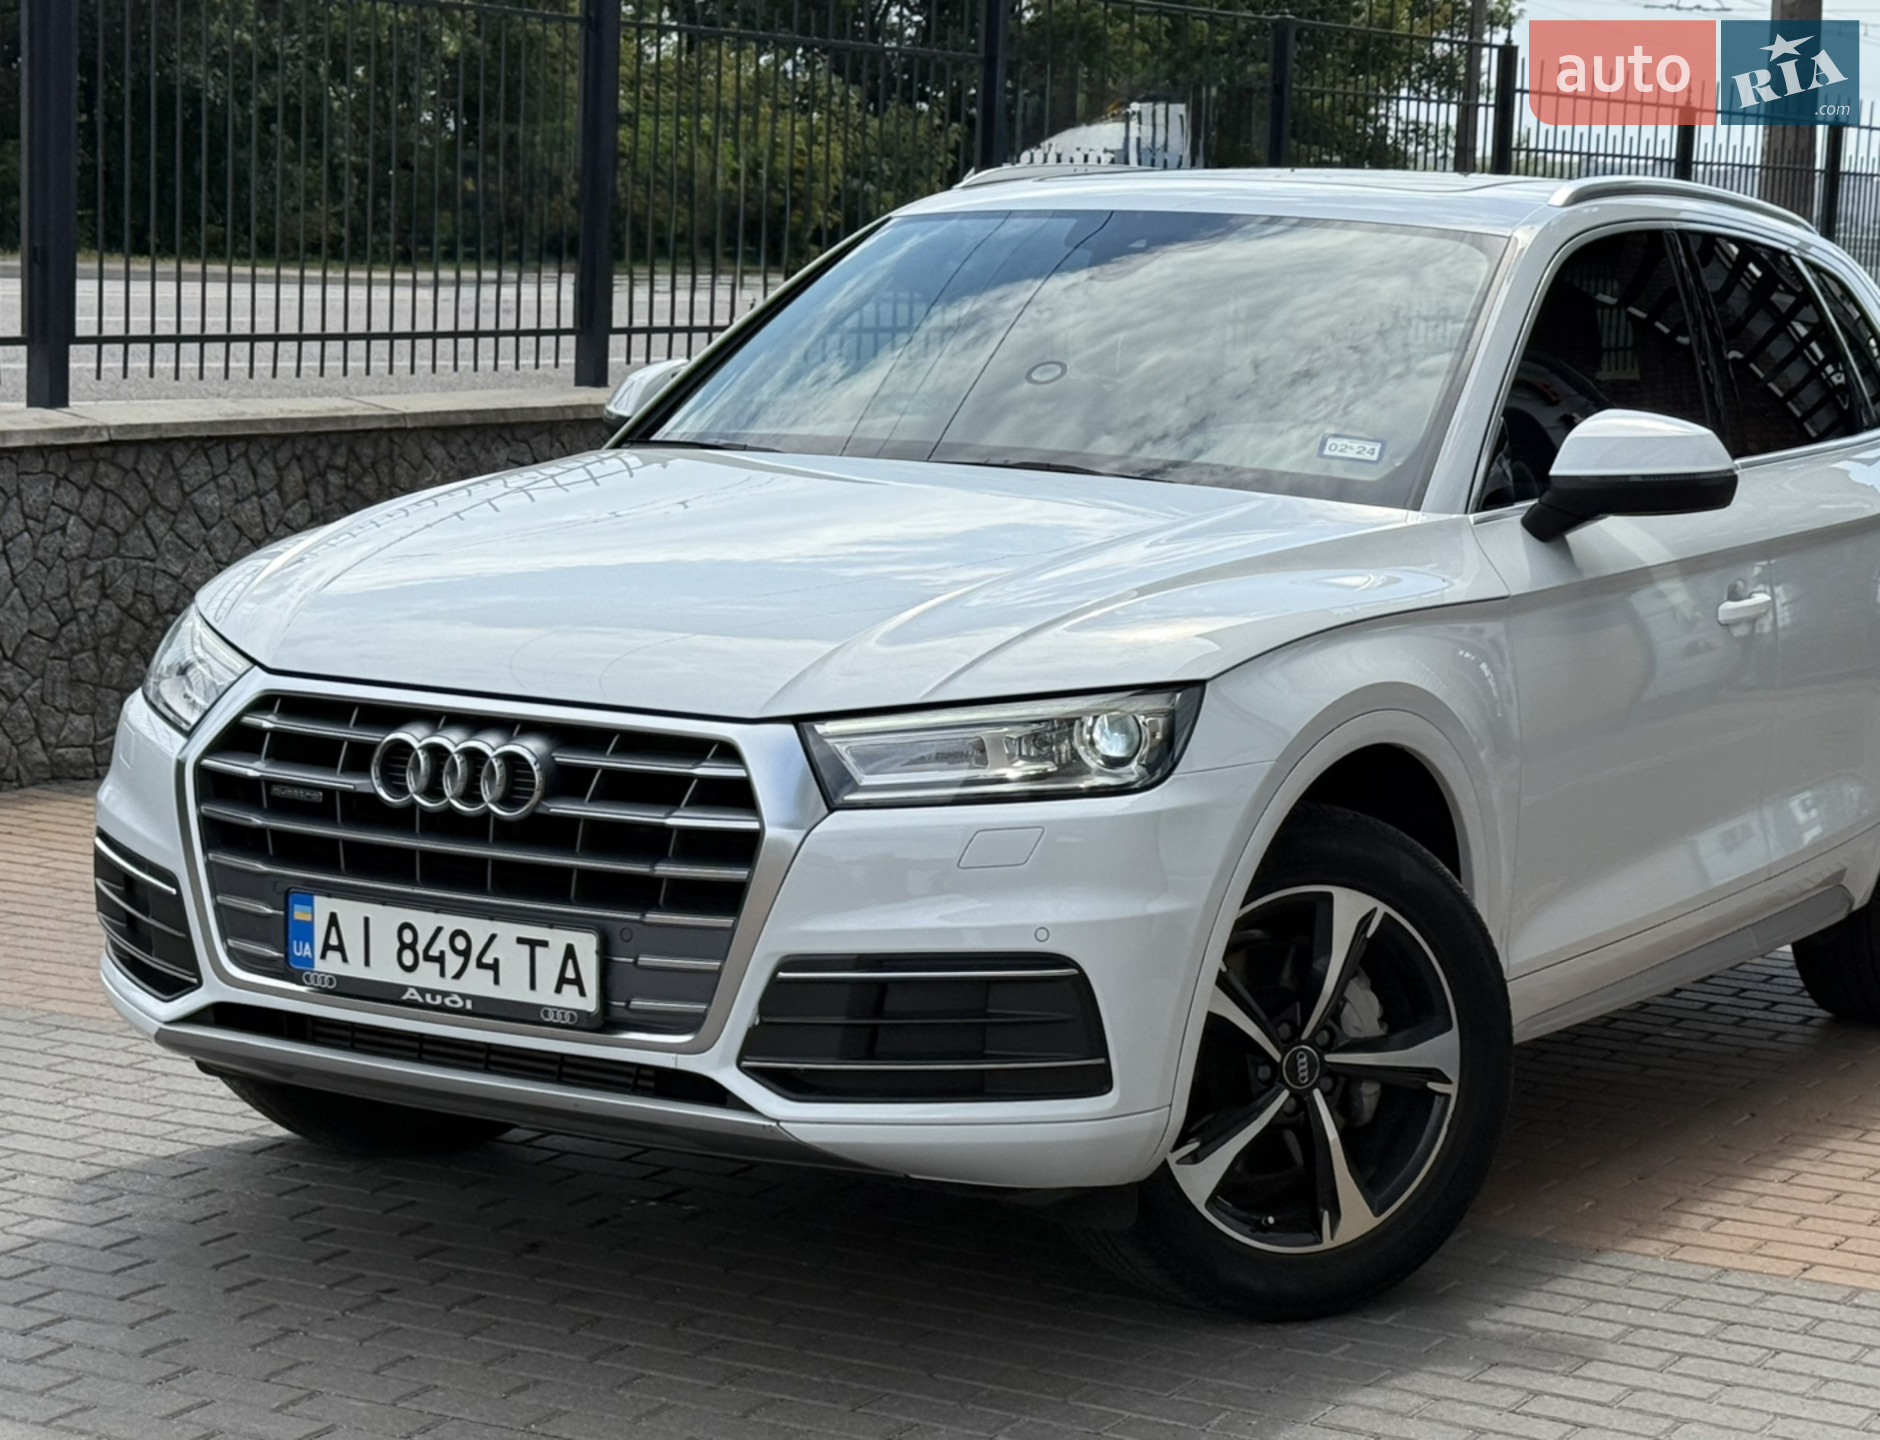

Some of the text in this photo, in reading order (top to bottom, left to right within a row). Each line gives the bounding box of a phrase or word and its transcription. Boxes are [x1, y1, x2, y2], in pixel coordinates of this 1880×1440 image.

[293, 939, 312, 959] UA
[320, 911, 587, 998] AI 8494 TA
[401, 987, 472, 1010] Audi
